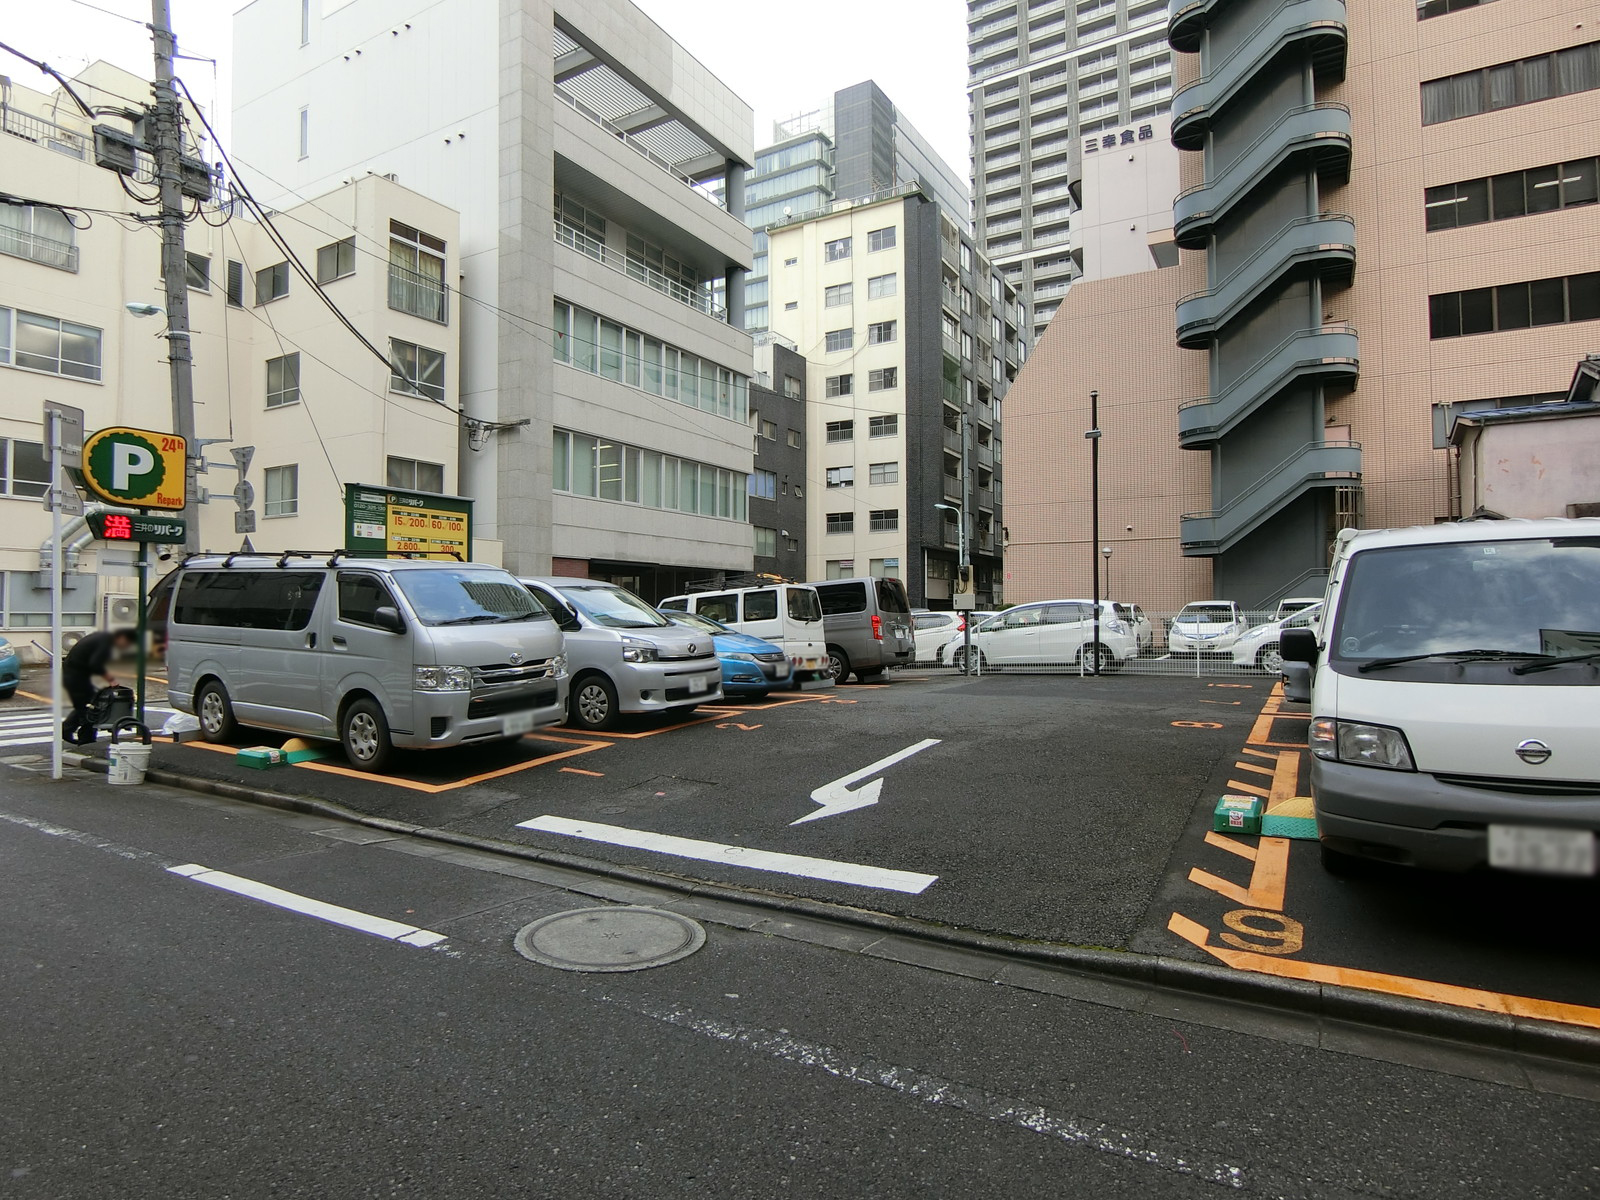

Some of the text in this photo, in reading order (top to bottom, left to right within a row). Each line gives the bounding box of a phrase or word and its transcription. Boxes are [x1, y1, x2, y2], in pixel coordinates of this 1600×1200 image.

[162, 437, 183, 453] 24h
[113, 442, 154, 491] P
[157, 492, 183, 506] Repark
[104, 514, 132, 539] 満
[134, 523, 183, 537] 三井のリパーク
[1219, 909, 1304, 955] 9
